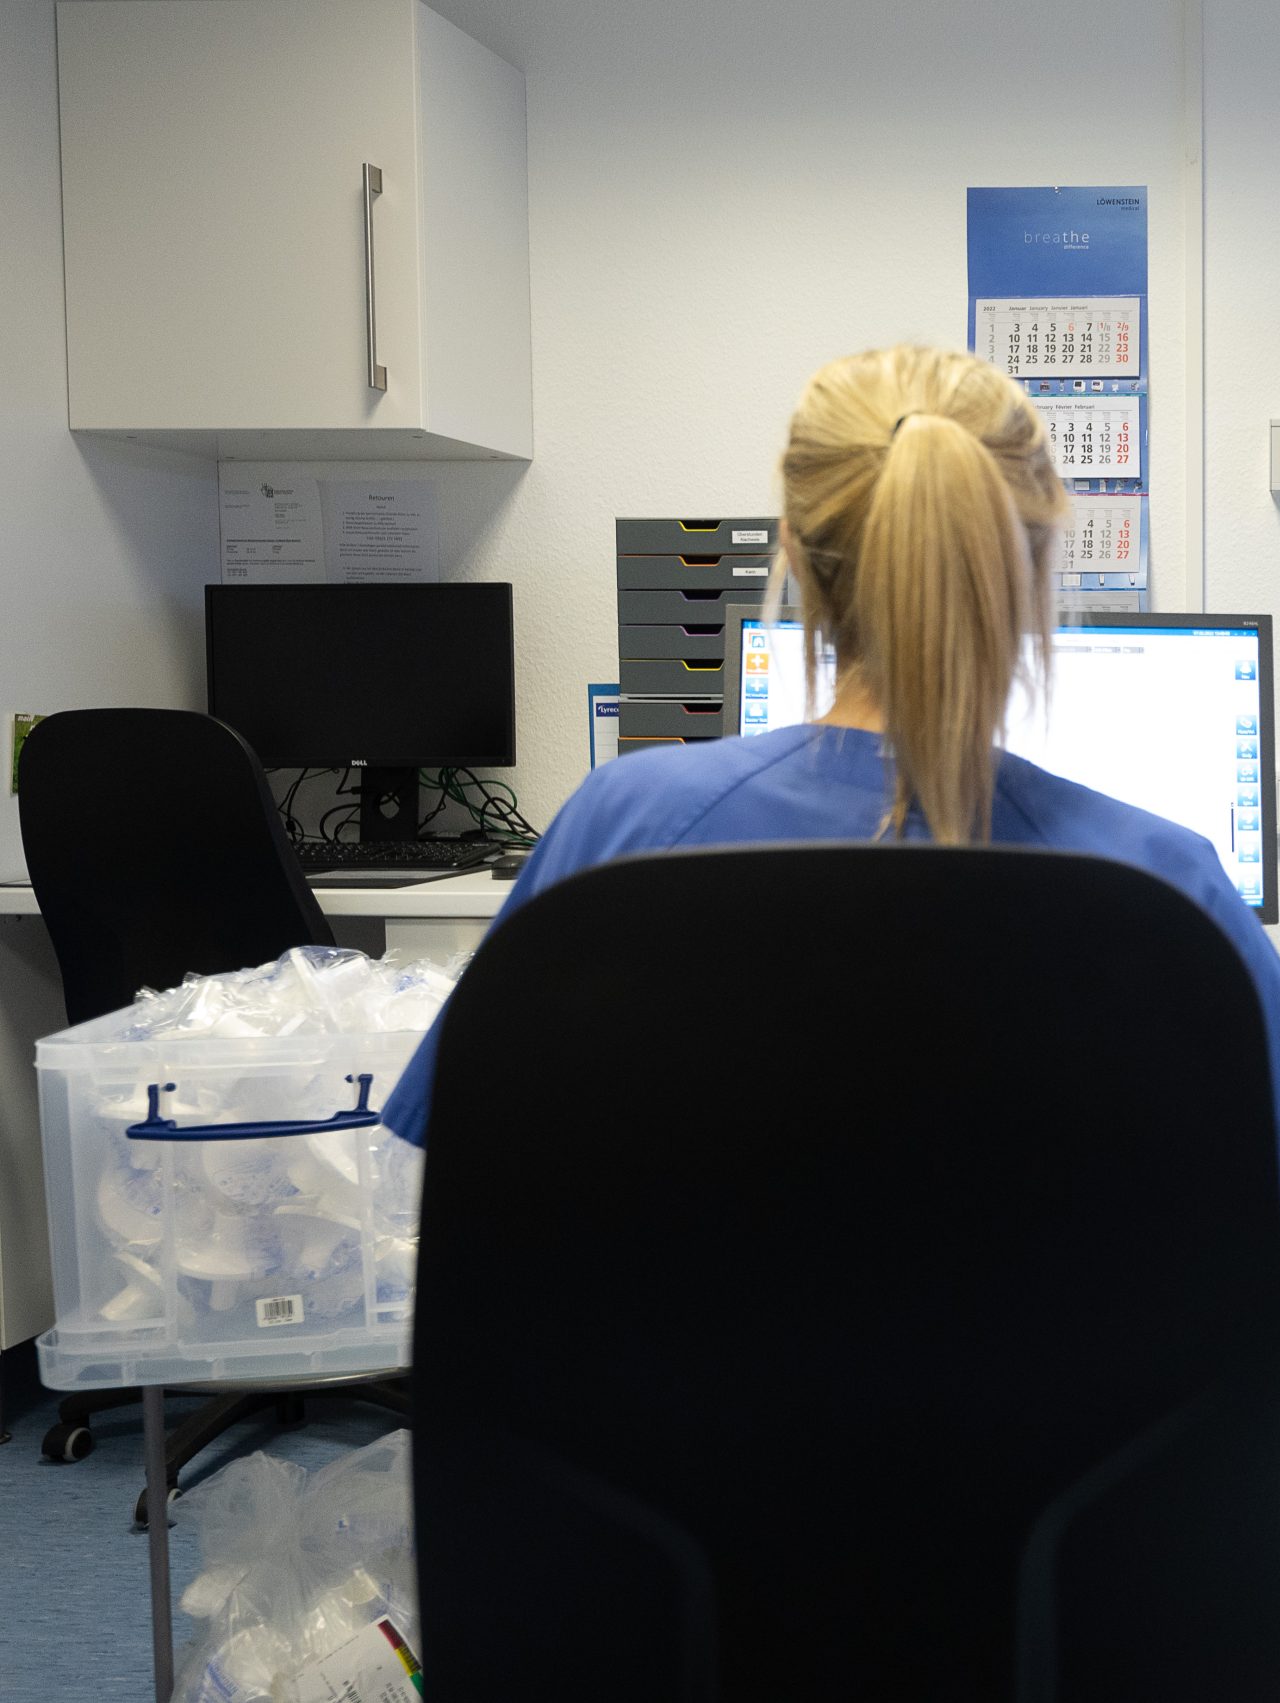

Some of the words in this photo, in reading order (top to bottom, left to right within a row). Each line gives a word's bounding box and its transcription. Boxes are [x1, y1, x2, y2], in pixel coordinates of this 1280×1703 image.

[1024, 230, 1090, 244] breathe
[990, 324, 995, 332] 1
[1015, 324, 1020, 332] 3
[1032, 324, 1038, 332] 4
[1051, 323, 1056, 332] 5
[1068, 323, 1074, 331] 6
[1087, 323, 1092, 331] 7
[989, 335, 995, 343] 2
[1027, 334, 1037, 342] 11
[1045, 334, 1056, 342] 12
[1063, 334, 1074, 342] 13
[1081, 334, 1092, 342] 14
[1099, 334, 1110, 342] 15
[1117, 333, 1128, 341] 16
[989, 345, 995, 353] 3
[1009, 345, 1019, 353] 17
[1027, 345, 1038, 353] 18
[1045, 345, 1056, 353] 19
[1063, 344, 1074, 353] 20
[1080, 344, 1091, 352] 21
[1098, 344, 1110, 352] 22
[1116, 344, 1128, 352] 23
[1008, 356, 1019, 364] 24
[1027, 355, 1037, 363] 25
[1045, 355, 1056, 363] 26
[1063, 355, 1074, 363] 27
[1080, 355, 1092, 363] 28
[1098, 355, 1110, 363] 29
[1116, 354, 1128, 362] 30
[1008, 366, 1018, 374] 31
[1051, 423, 1056, 431] 2
[1069, 423, 1074, 431] 3
[1086, 423, 1092, 431] 4
[1105, 423, 1110, 431] 5
[1123, 423, 1128, 431] 6
[1051, 434, 1056, 442] 9
[1063, 434, 1074, 442] 10
[1082, 434, 1091, 442] 11
[1100, 433, 1110, 442] 12
[1118, 433, 1128, 442] 13
[1064, 445, 1074, 453] 17
[1082, 444, 1093, 453] 18
[1100, 444, 1110, 453] 19
[1117, 444, 1129, 452] 20
[1063, 455, 1075, 464] 24
[1081, 455, 1092, 464] 25
[1099, 455, 1111, 463] 26
[1117, 455, 1128, 463] 27
[1106, 520, 1111, 528] 5
[1124, 520, 1130, 528] 6
[1083, 530, 1092, 538] 11
[1101, 530, 1111, 538] 12
[1119, 530, 1129, 538] 13
[1082, 540, 1093, 548] 18
[1100, 540, 1111, 548] 19
[1117, 540, 1129, 548] 20
[1081, 550, 1092, 558] 25
[1099, 550, 1111, 559] 26
[1117, 550, 1129, 560] 27
